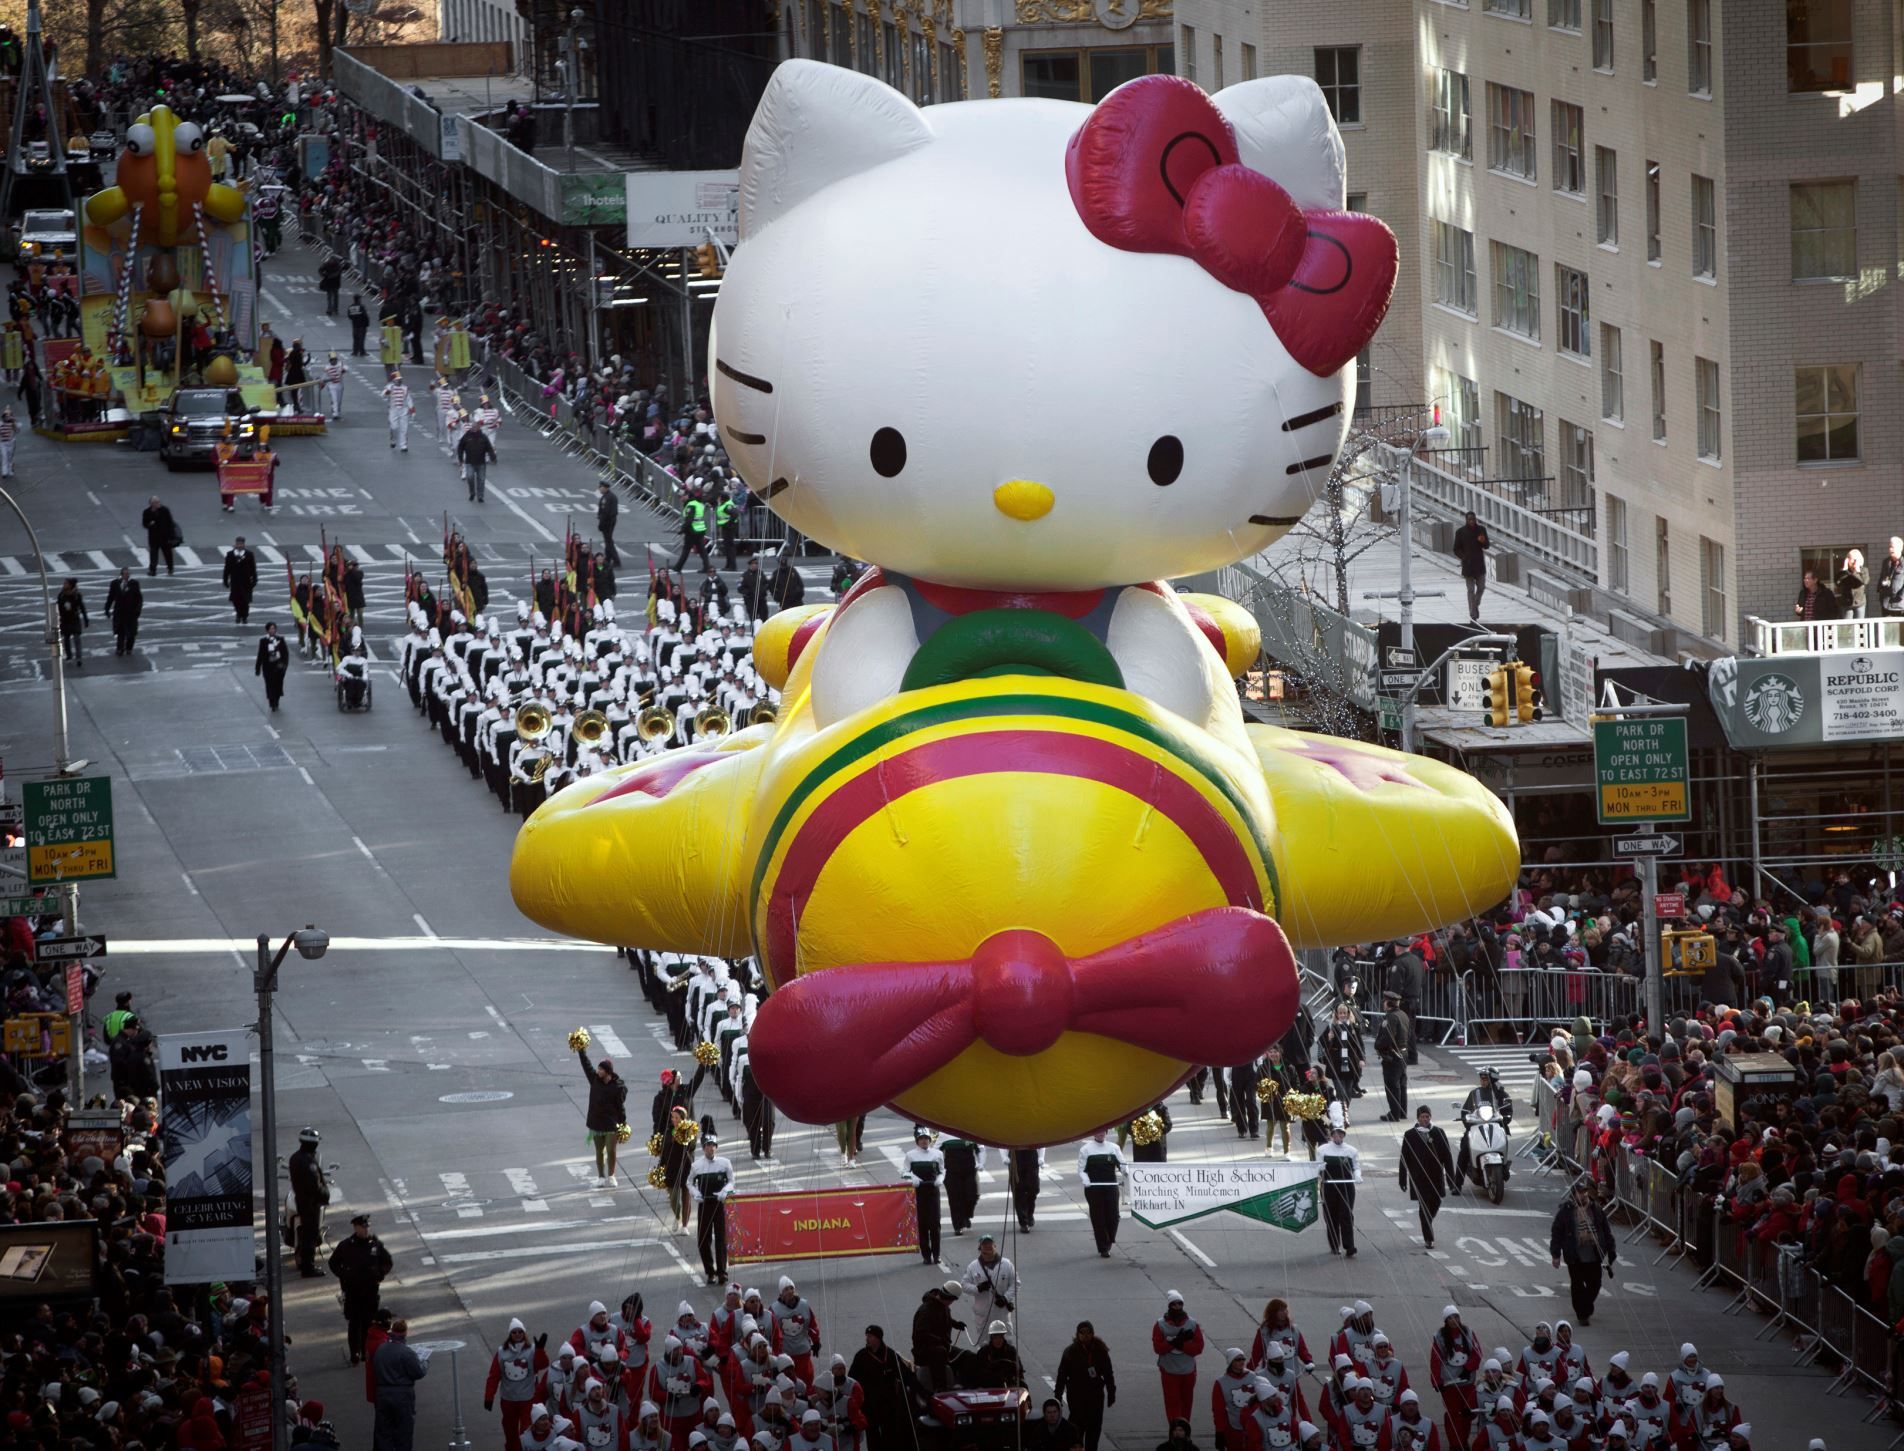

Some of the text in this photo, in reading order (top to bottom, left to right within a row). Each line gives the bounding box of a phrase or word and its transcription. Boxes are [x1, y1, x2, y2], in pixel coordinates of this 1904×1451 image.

[583, 194, 625, 206] 1hotels
[655, 213, 720, 224] QUALITY
[506, 487, 603, 498] ONLY
[1458, 664, 1490, 674] BUSES
[1388, 675, 1405, 684] ONE
[1827, 672, 1899, 687] REPUBLIC
[1461, 682, 1482, 692] ONL
[1827, 685, 1900, 696] SCAFFOLD CORP.
[1833, 709, 1897, 720] 718-402-3400
[1616, 724, 1664, 737] PARK DR
[1623, 739, 1659, 751] NORTH
[1543, 753, 1594, 768] COFFE
[1611, 753, 1672, 766] OPEN ONLY
[1601, 767, 1684, 781] TO EAST 72 ST
[43, 782, 91, 797] PARK DR
[1617, 788, 1641, 798] 10AM
[1651, 786, 1670, 798] 3PM
[50, 797, 86, 811] NORTH
[1607, 800, 1682, 814] MON THRU FRI
[38, 811, 98, 827] OPEN ONLY
[29, 825, 111, 843] TO EAST 72 ST
[1623, 839, 1671, 851] ONE WAY
[35, 864, 57, 876] MON
[89, 859, 108, 871] FRI
[45, 942, 95, 955] ONE WAY
[181, 1044, 228, 1063] NYC
[175, 1079, 203, 1092] NEW
[207, 1077, 249, 1090] VISION
[1132, 1169, 1275, 1187] Concord High School
[1134, 1185, 1240, 1199] Marching Minutemen
[174, 1200, 246, 1214] CELEBRATING
[1174, 1199, 1185, 1210] IN
[185, 1211, 234, 1223] 87 YEARS
[793, 1217, 851, 1232] INDIANA
